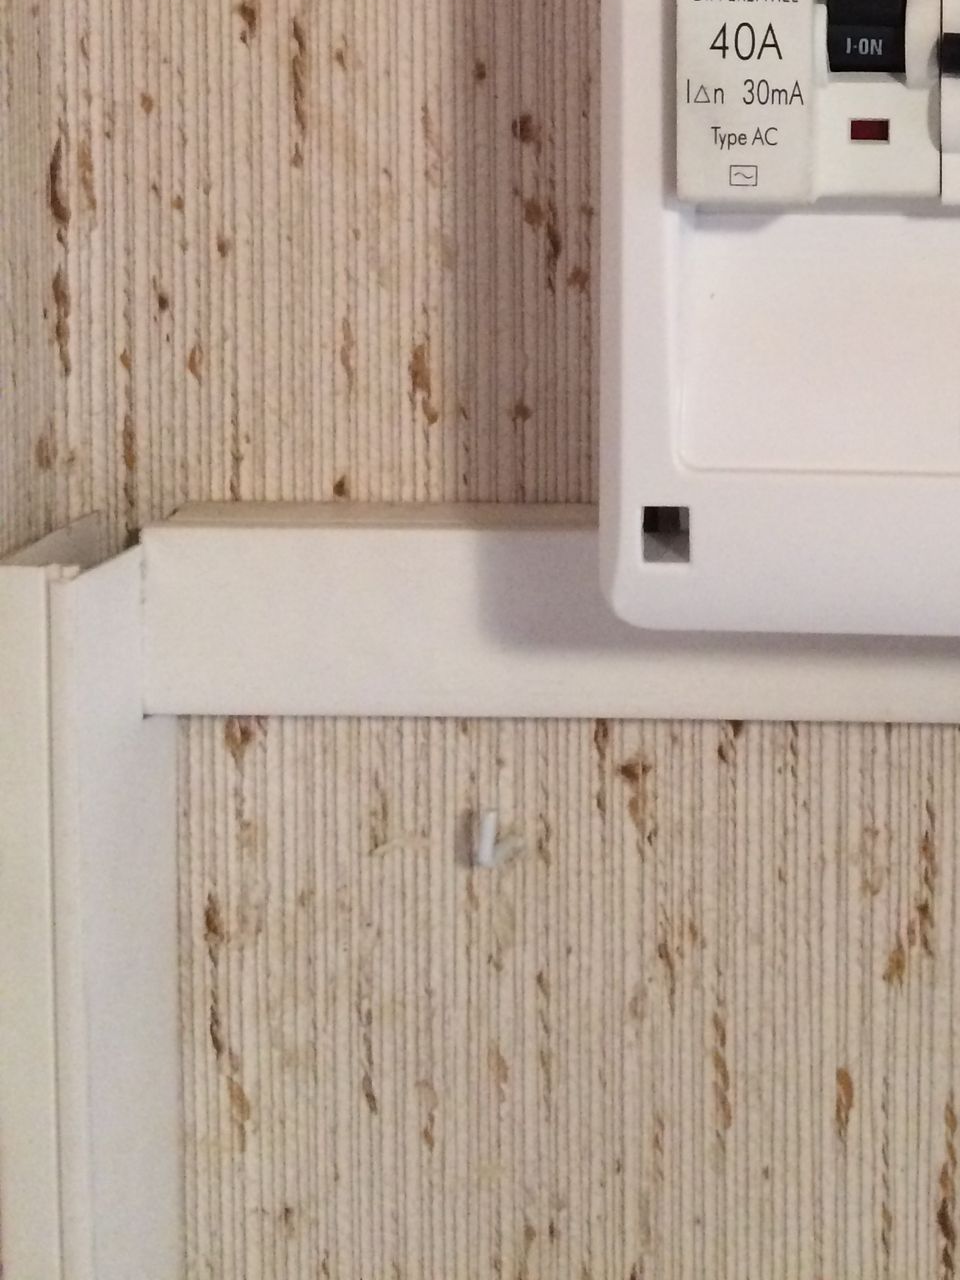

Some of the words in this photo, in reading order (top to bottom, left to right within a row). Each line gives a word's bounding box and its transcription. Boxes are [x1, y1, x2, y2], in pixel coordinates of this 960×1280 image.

[709, 22, 783, 61] 40A
[742, 78, 804, 106] 30mA
[711, 126, 748, 151] Type
[751, 127, 779, 146] AC
